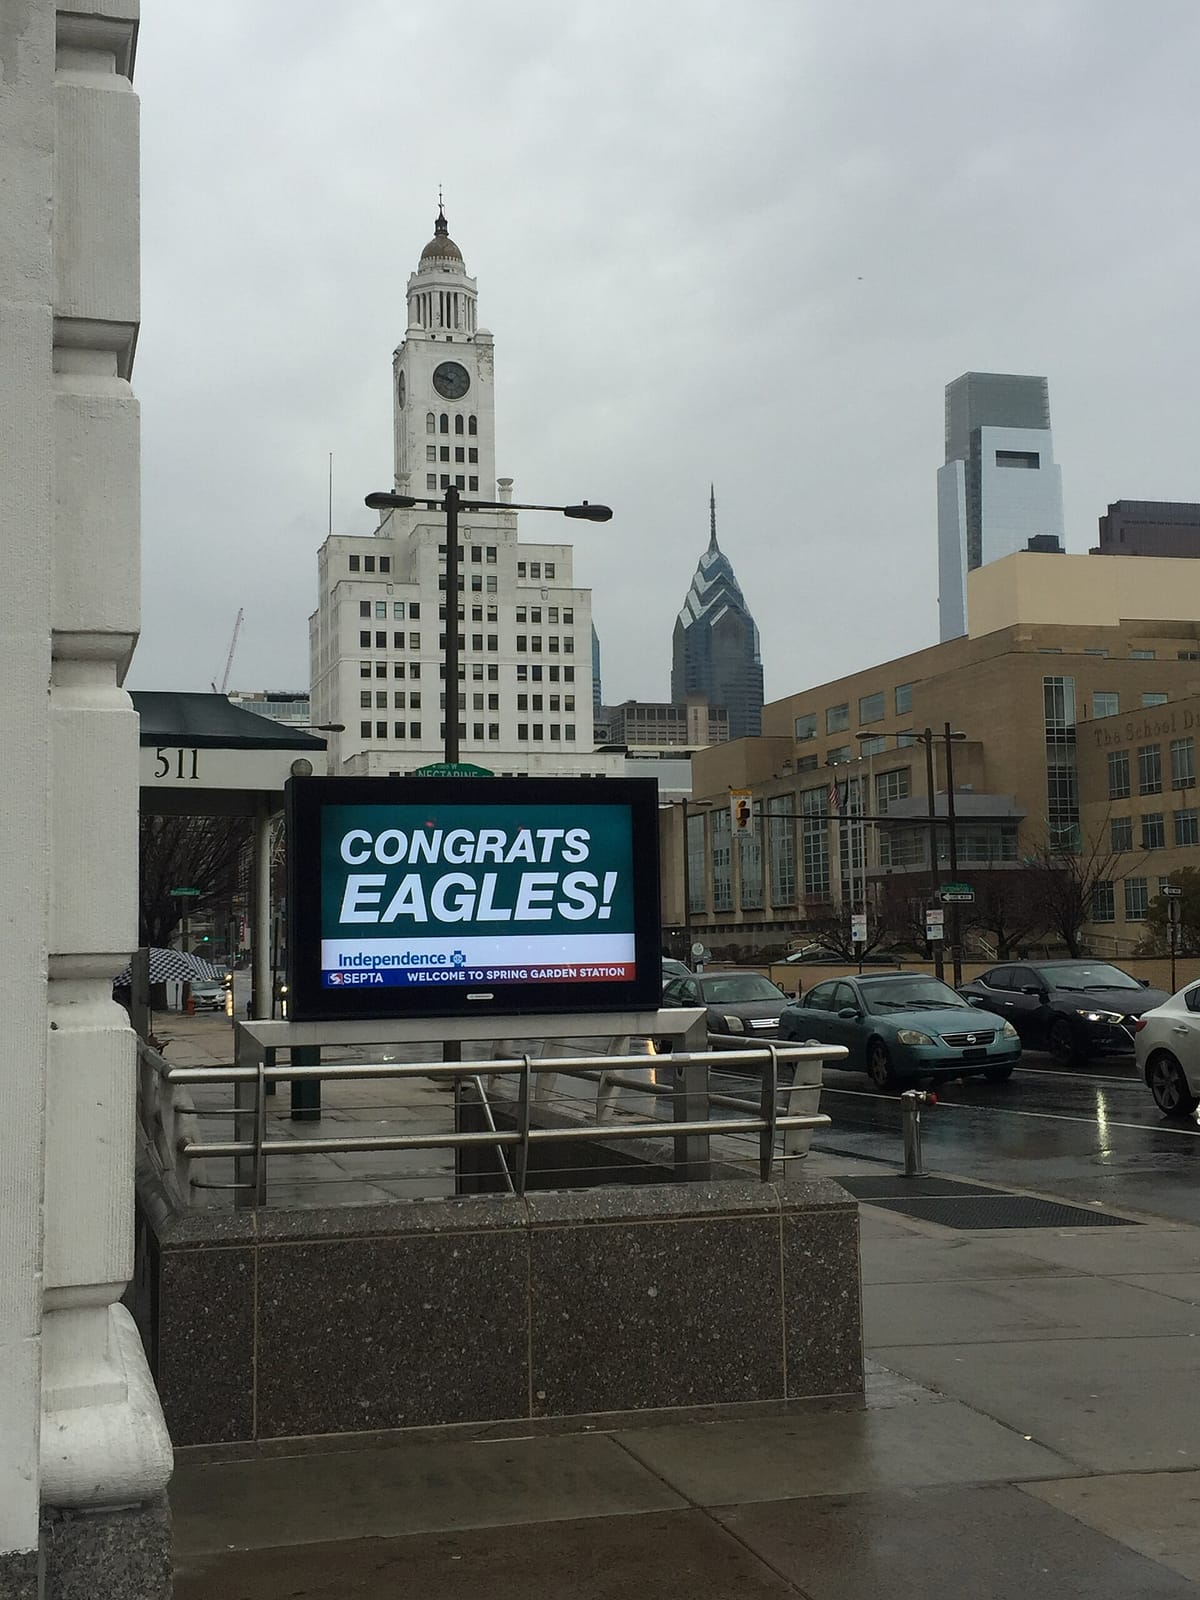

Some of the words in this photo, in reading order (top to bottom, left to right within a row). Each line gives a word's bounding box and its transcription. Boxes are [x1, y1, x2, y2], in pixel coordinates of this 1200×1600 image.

[1094, 728, 1121, 748] The
[1126, 713, 1177, 741] School
[154, 747, 200, 780] 511
[340, 828, 591, 865] CONGRATS
[339, 870, 618, 923] EAGLES!
[339, 951, 447, 969] Independence
[407, 971, 466, 982] WELCOME
[468, 970, 484, 980] TO
[486, 969, 528, 979] SPRING
[530, 968, 577, 979] GARDEN
[579, 967, 625, 978] STATION
[343, 972, 384, 984] SEPTA
